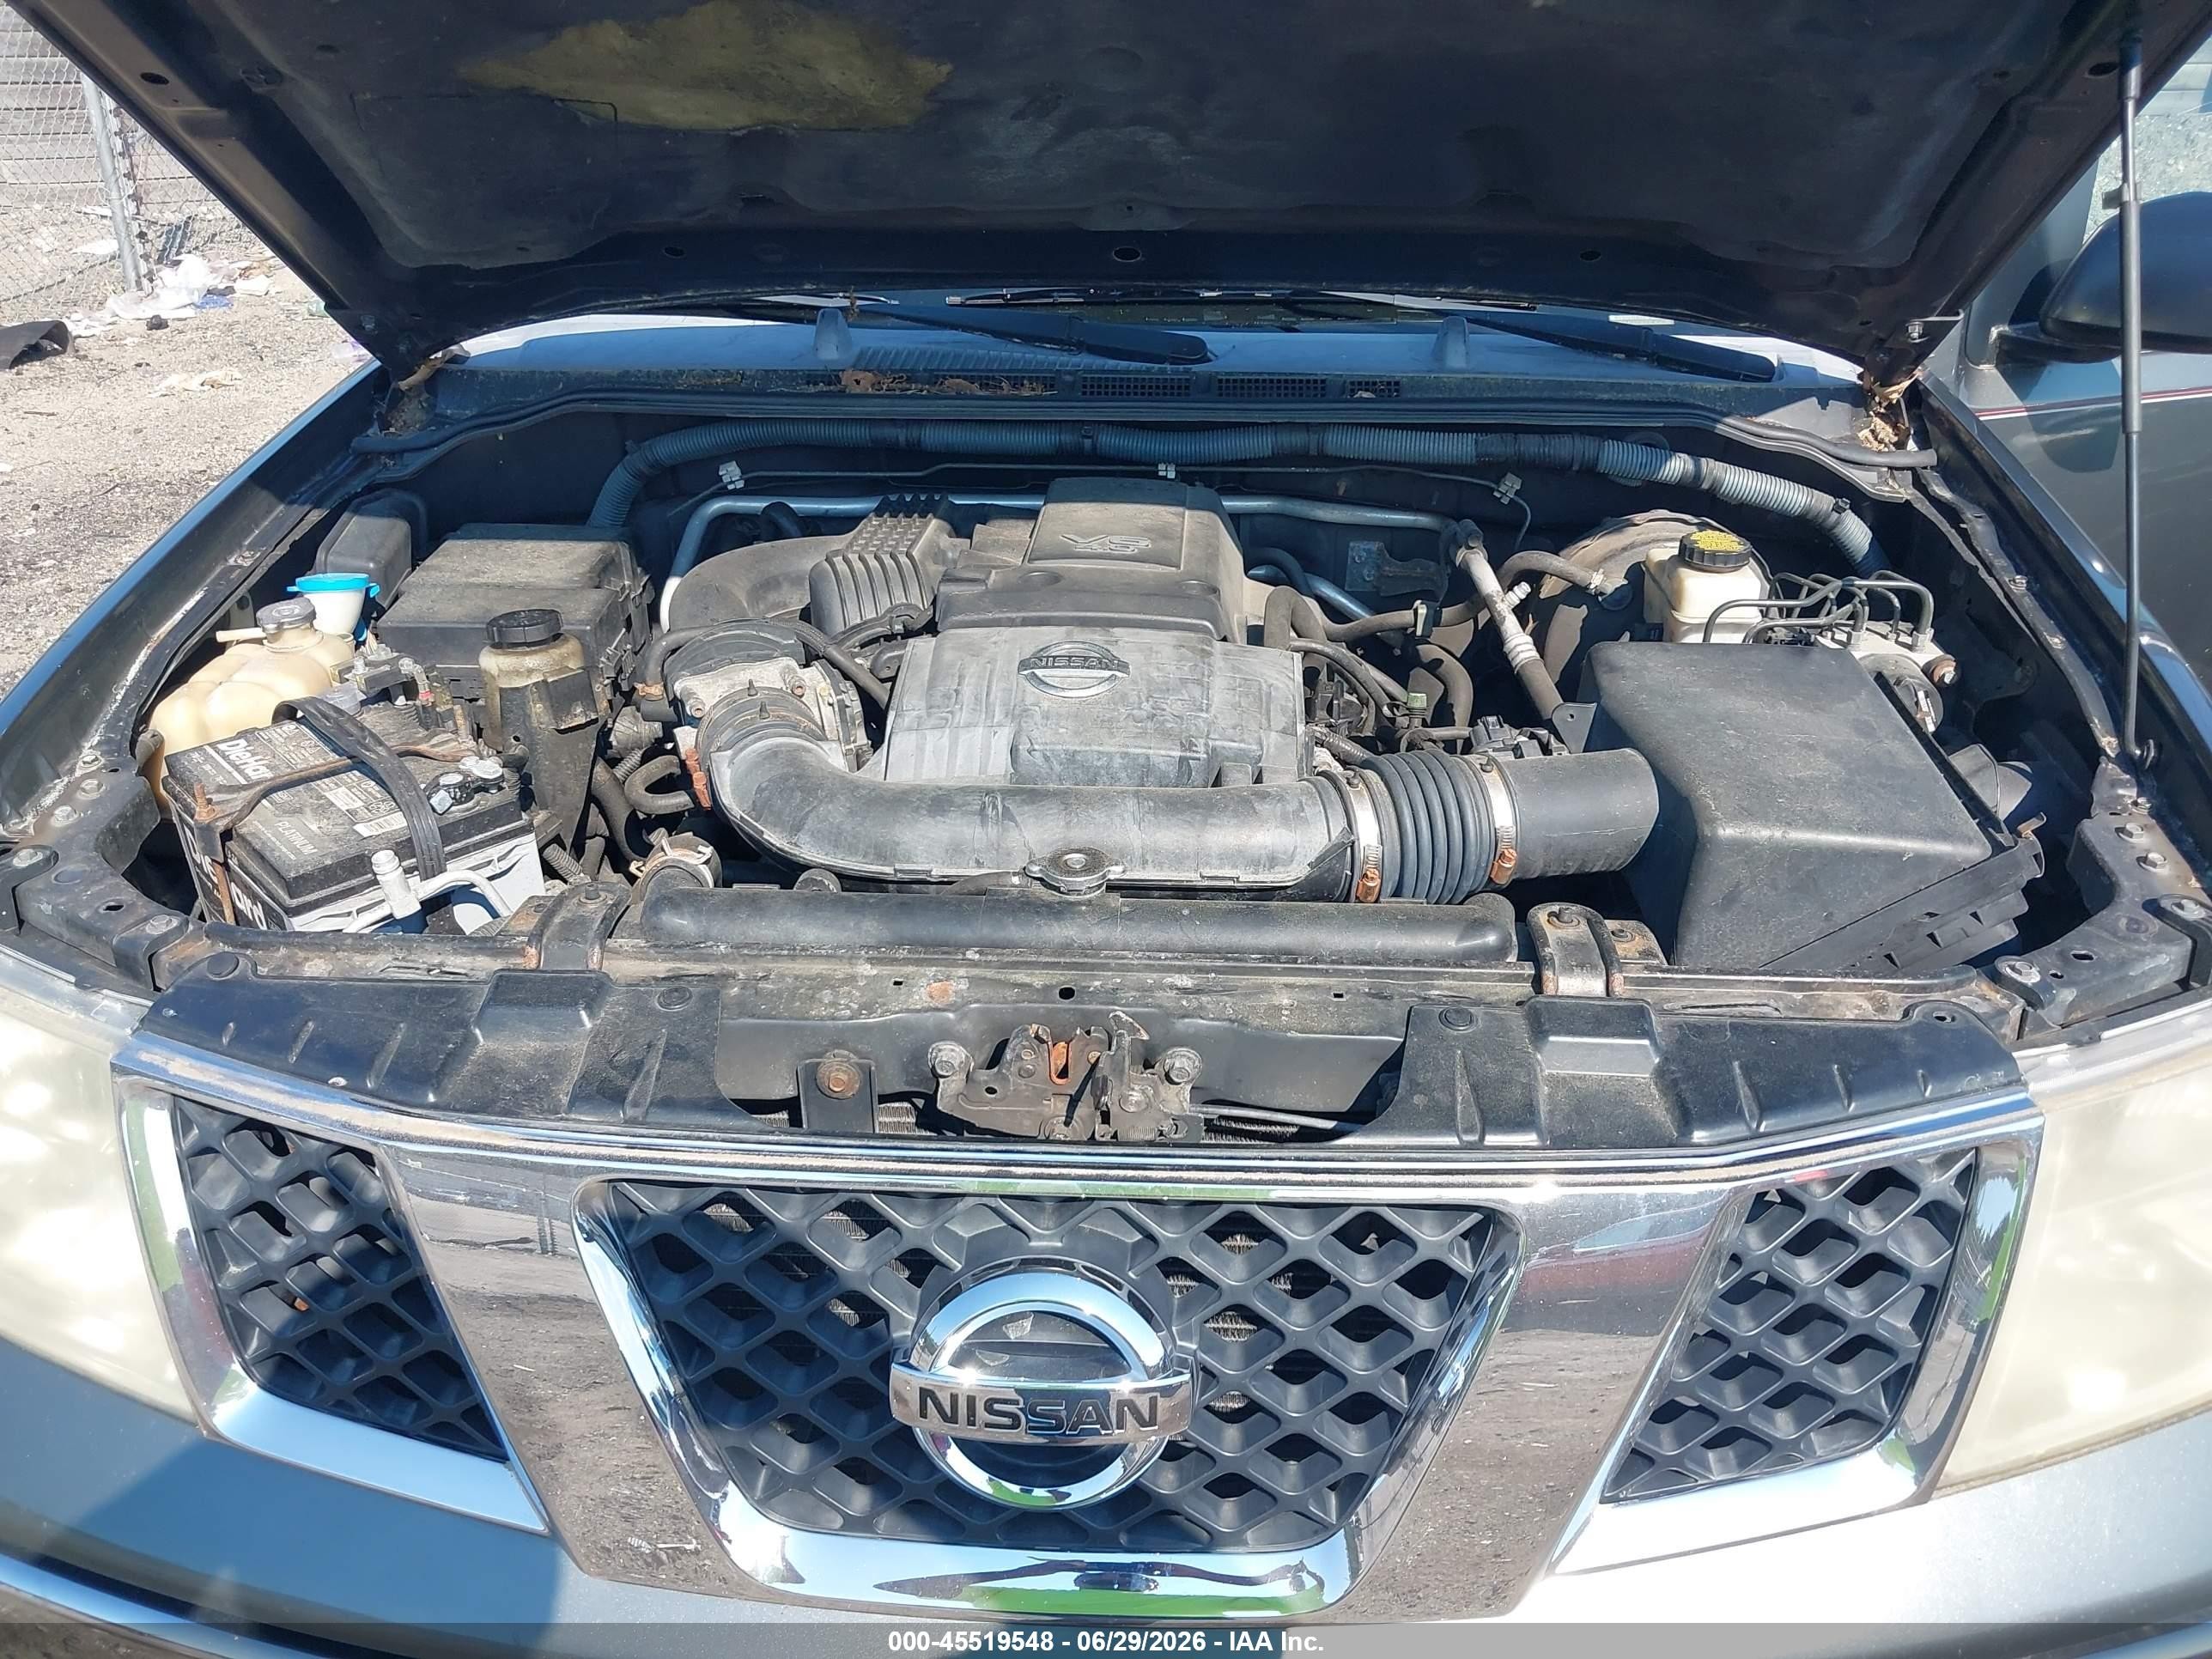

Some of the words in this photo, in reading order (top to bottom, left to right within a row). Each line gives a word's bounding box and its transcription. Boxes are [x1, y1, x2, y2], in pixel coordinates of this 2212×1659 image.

[1030, 656, 1119, 670] NISSAN
[274, 820, 319, 856] PLATINUM
[918, 1386, 1159, 1436] NISSAN
